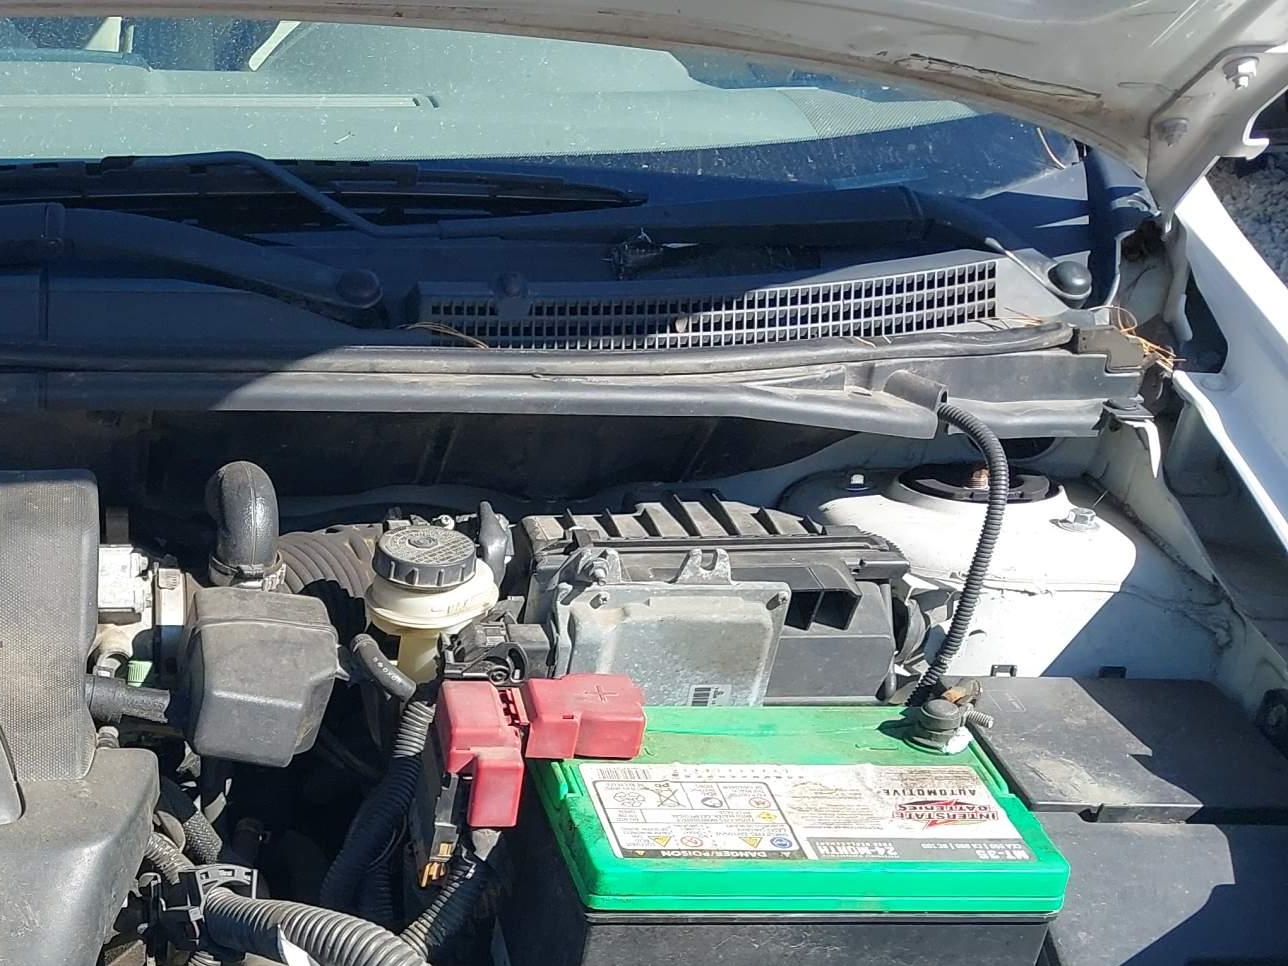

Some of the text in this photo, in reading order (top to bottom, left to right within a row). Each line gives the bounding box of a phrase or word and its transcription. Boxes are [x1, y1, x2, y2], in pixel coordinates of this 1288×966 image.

[882, 788, 977, 797] AUTOMOTIVE
[893, 811, 998, 820] INTERSTATE
[661, 850, 767, 858] DANGER/POISON
[817, 845, 898, 855] 24-MONTH
[976, 850, 1030, 860] MT-35
